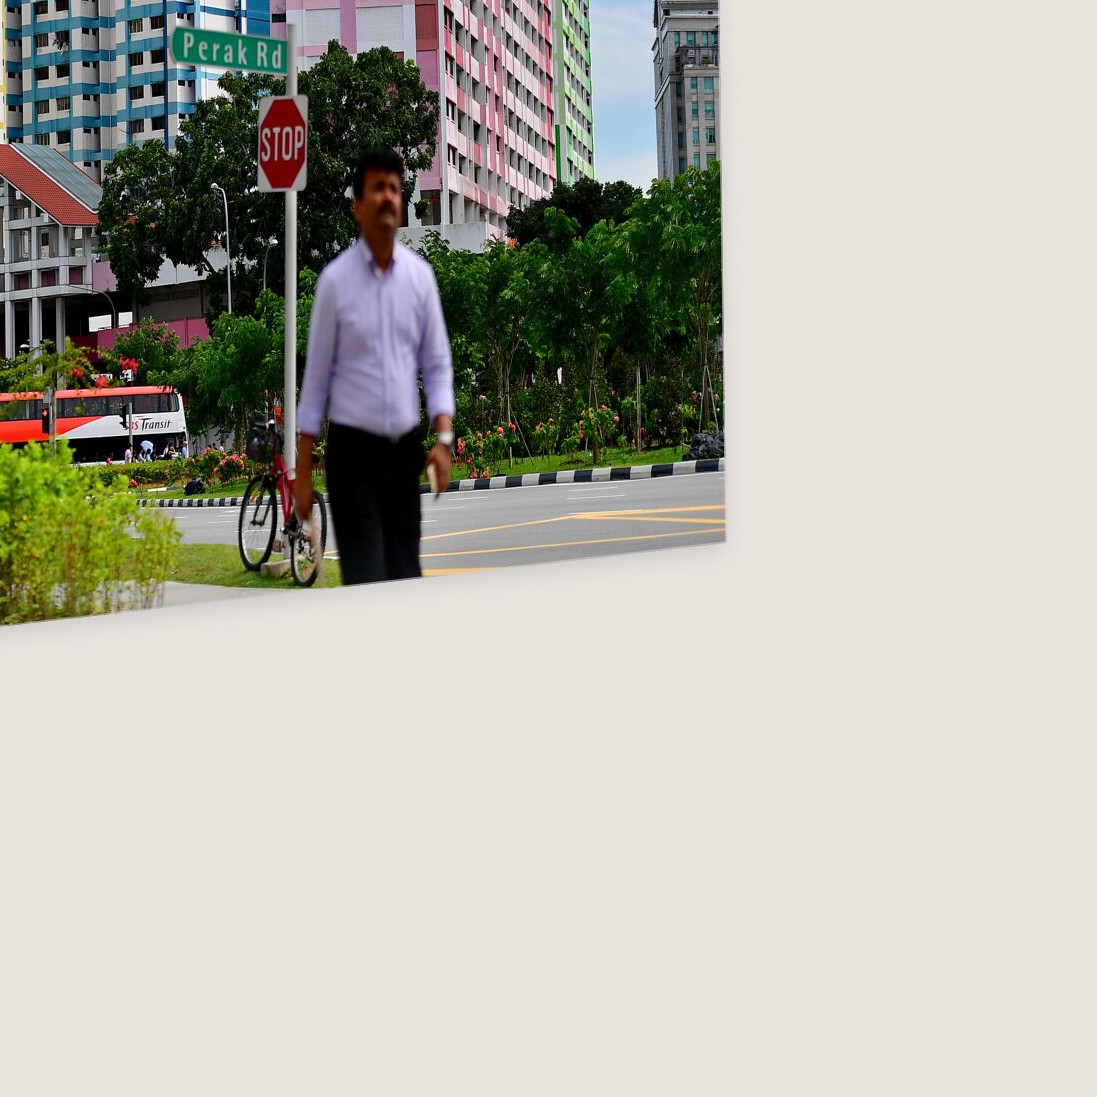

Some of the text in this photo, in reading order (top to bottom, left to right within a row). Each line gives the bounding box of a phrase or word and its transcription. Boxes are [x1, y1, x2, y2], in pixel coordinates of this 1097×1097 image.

[183, 32, 282, 70] Perak Rd
[261, 125, 304, 163] STOP
[139, 417, 172, 431] Transit
